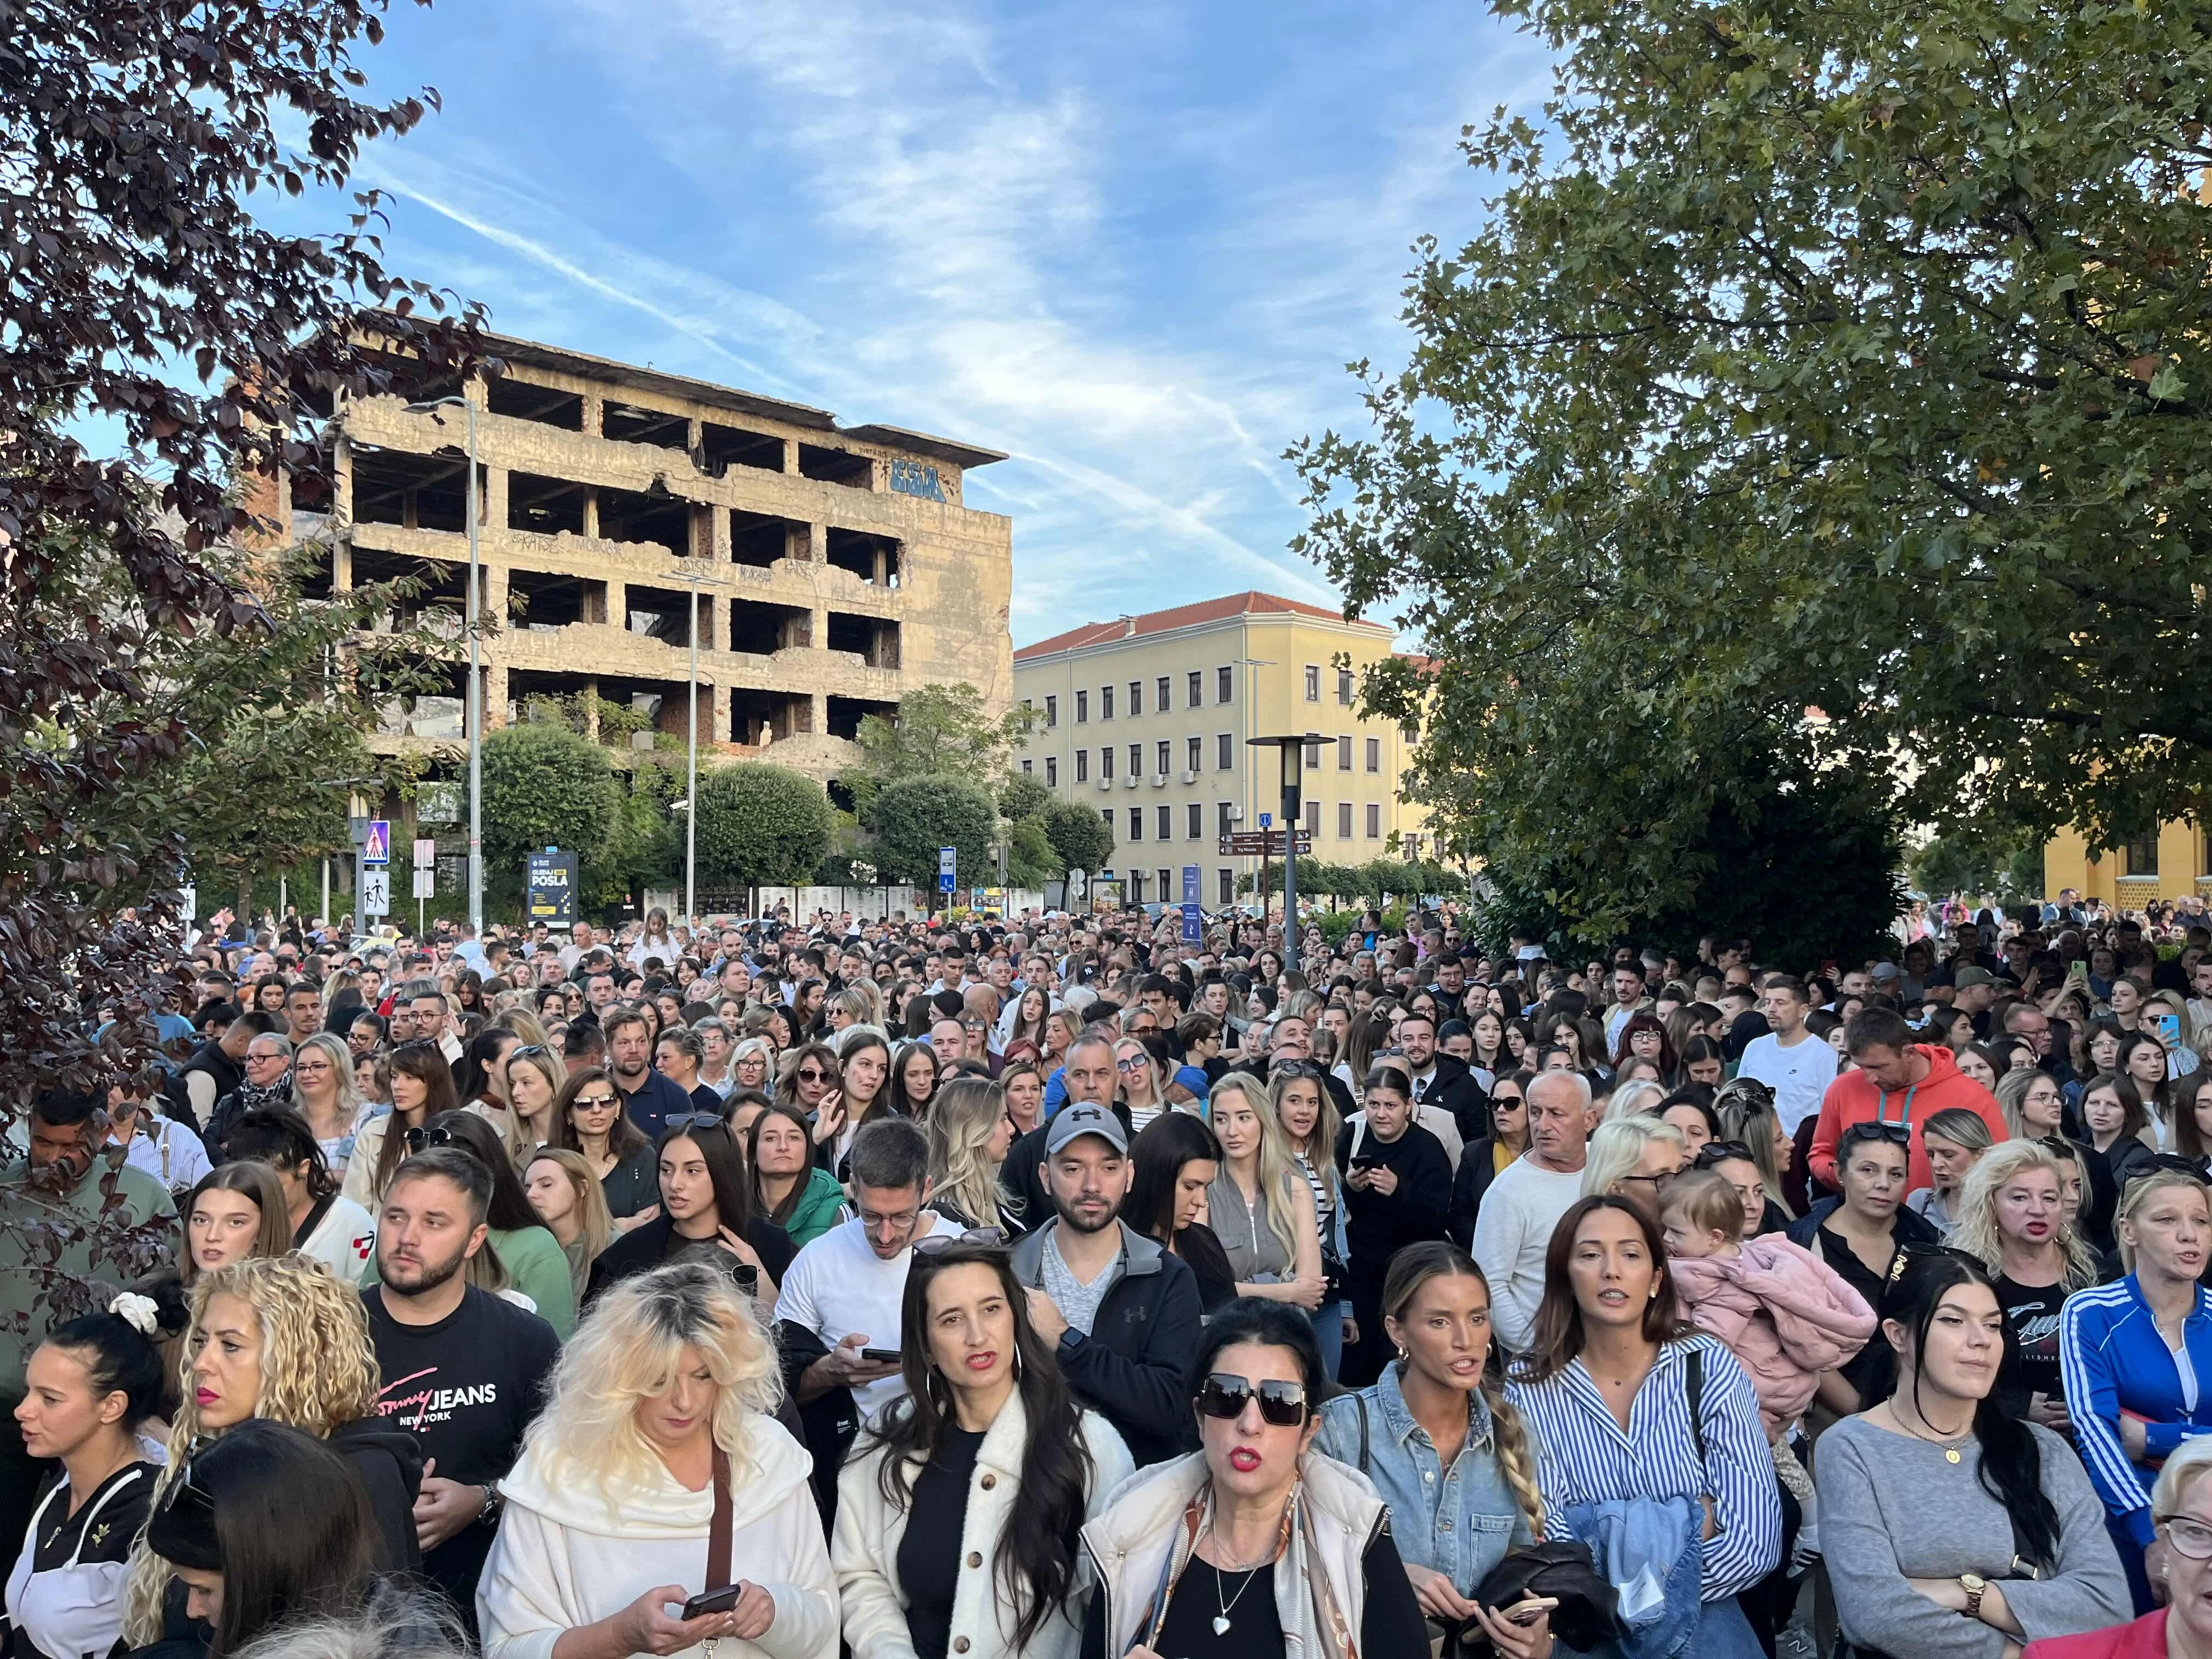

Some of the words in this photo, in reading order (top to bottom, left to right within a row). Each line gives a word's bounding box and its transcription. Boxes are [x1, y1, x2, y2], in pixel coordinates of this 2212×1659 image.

[532, 876, 568, 886] POSLA
[428, 1384, 496, 1410] JEANS
[400, 1416, 422, 1426] NEW
[424, 1411, 452, 1423] YORK
